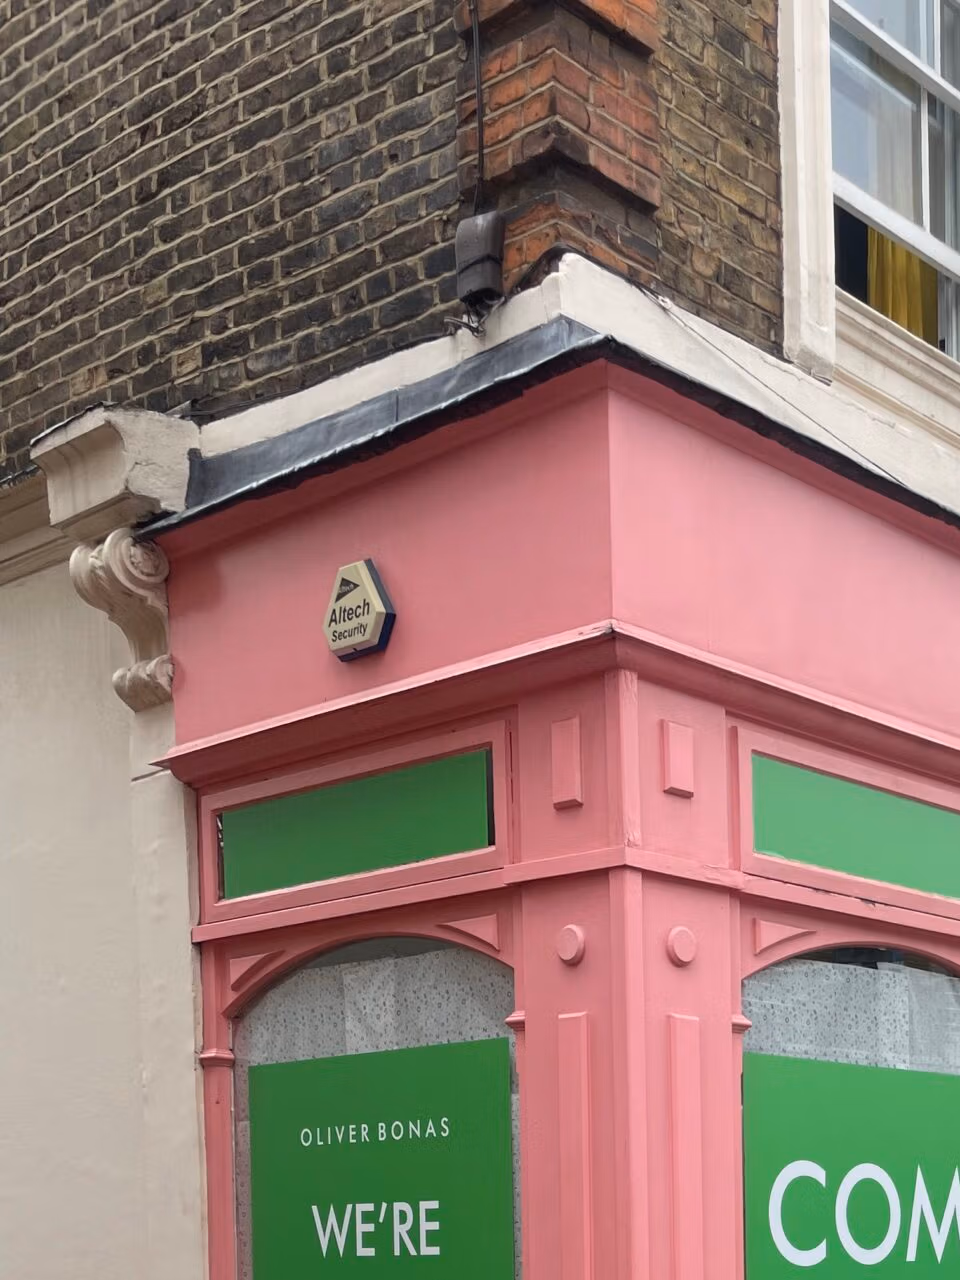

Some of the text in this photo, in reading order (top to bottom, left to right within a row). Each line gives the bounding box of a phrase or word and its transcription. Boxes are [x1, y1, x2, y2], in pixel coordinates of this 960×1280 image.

[328, 598, 370, 628] Altech
[331, 622, 368, 642] Security
[300, 1117, 451, 1147] OLIVER BONAS
[311, 1200, 441, 1258] WE'RE
